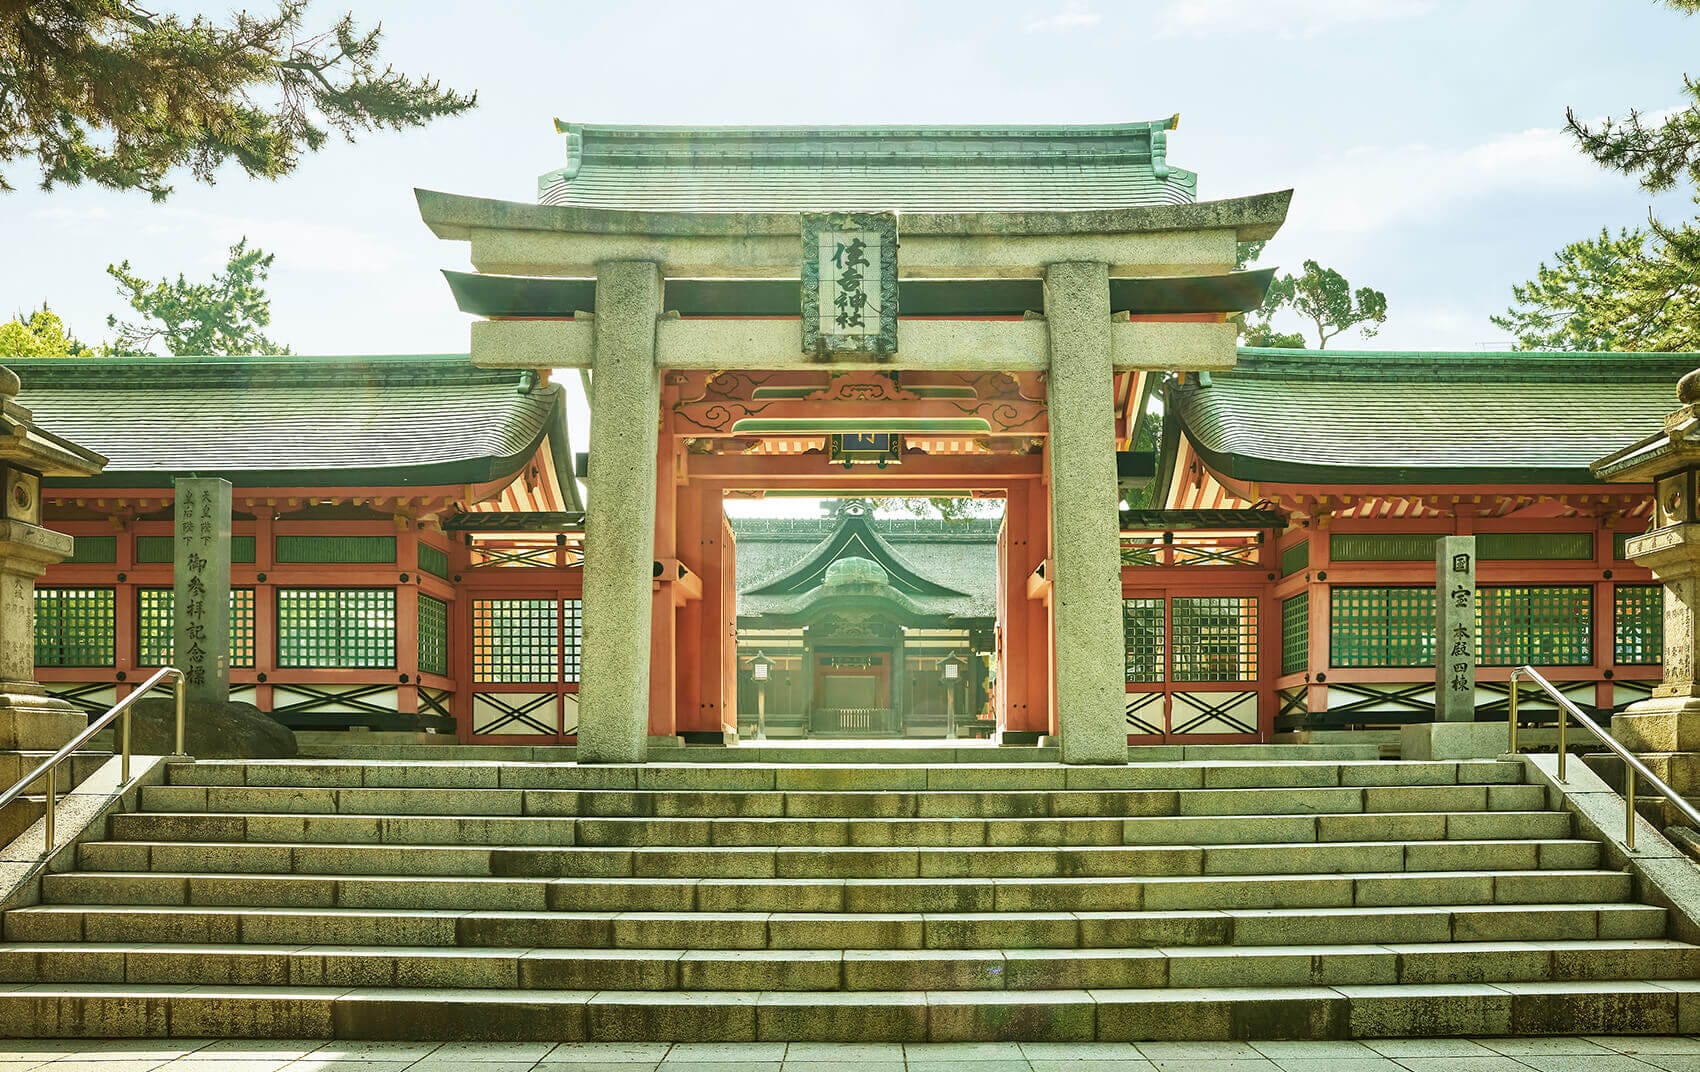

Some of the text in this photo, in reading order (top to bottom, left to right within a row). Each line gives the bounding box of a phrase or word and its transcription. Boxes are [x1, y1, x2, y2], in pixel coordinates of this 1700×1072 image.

[830, 237, 871, 330] 住吉神社
[182, 488, 194, 546] 皇后陛下
[200, 490, 212, 546] 天皇陛下
